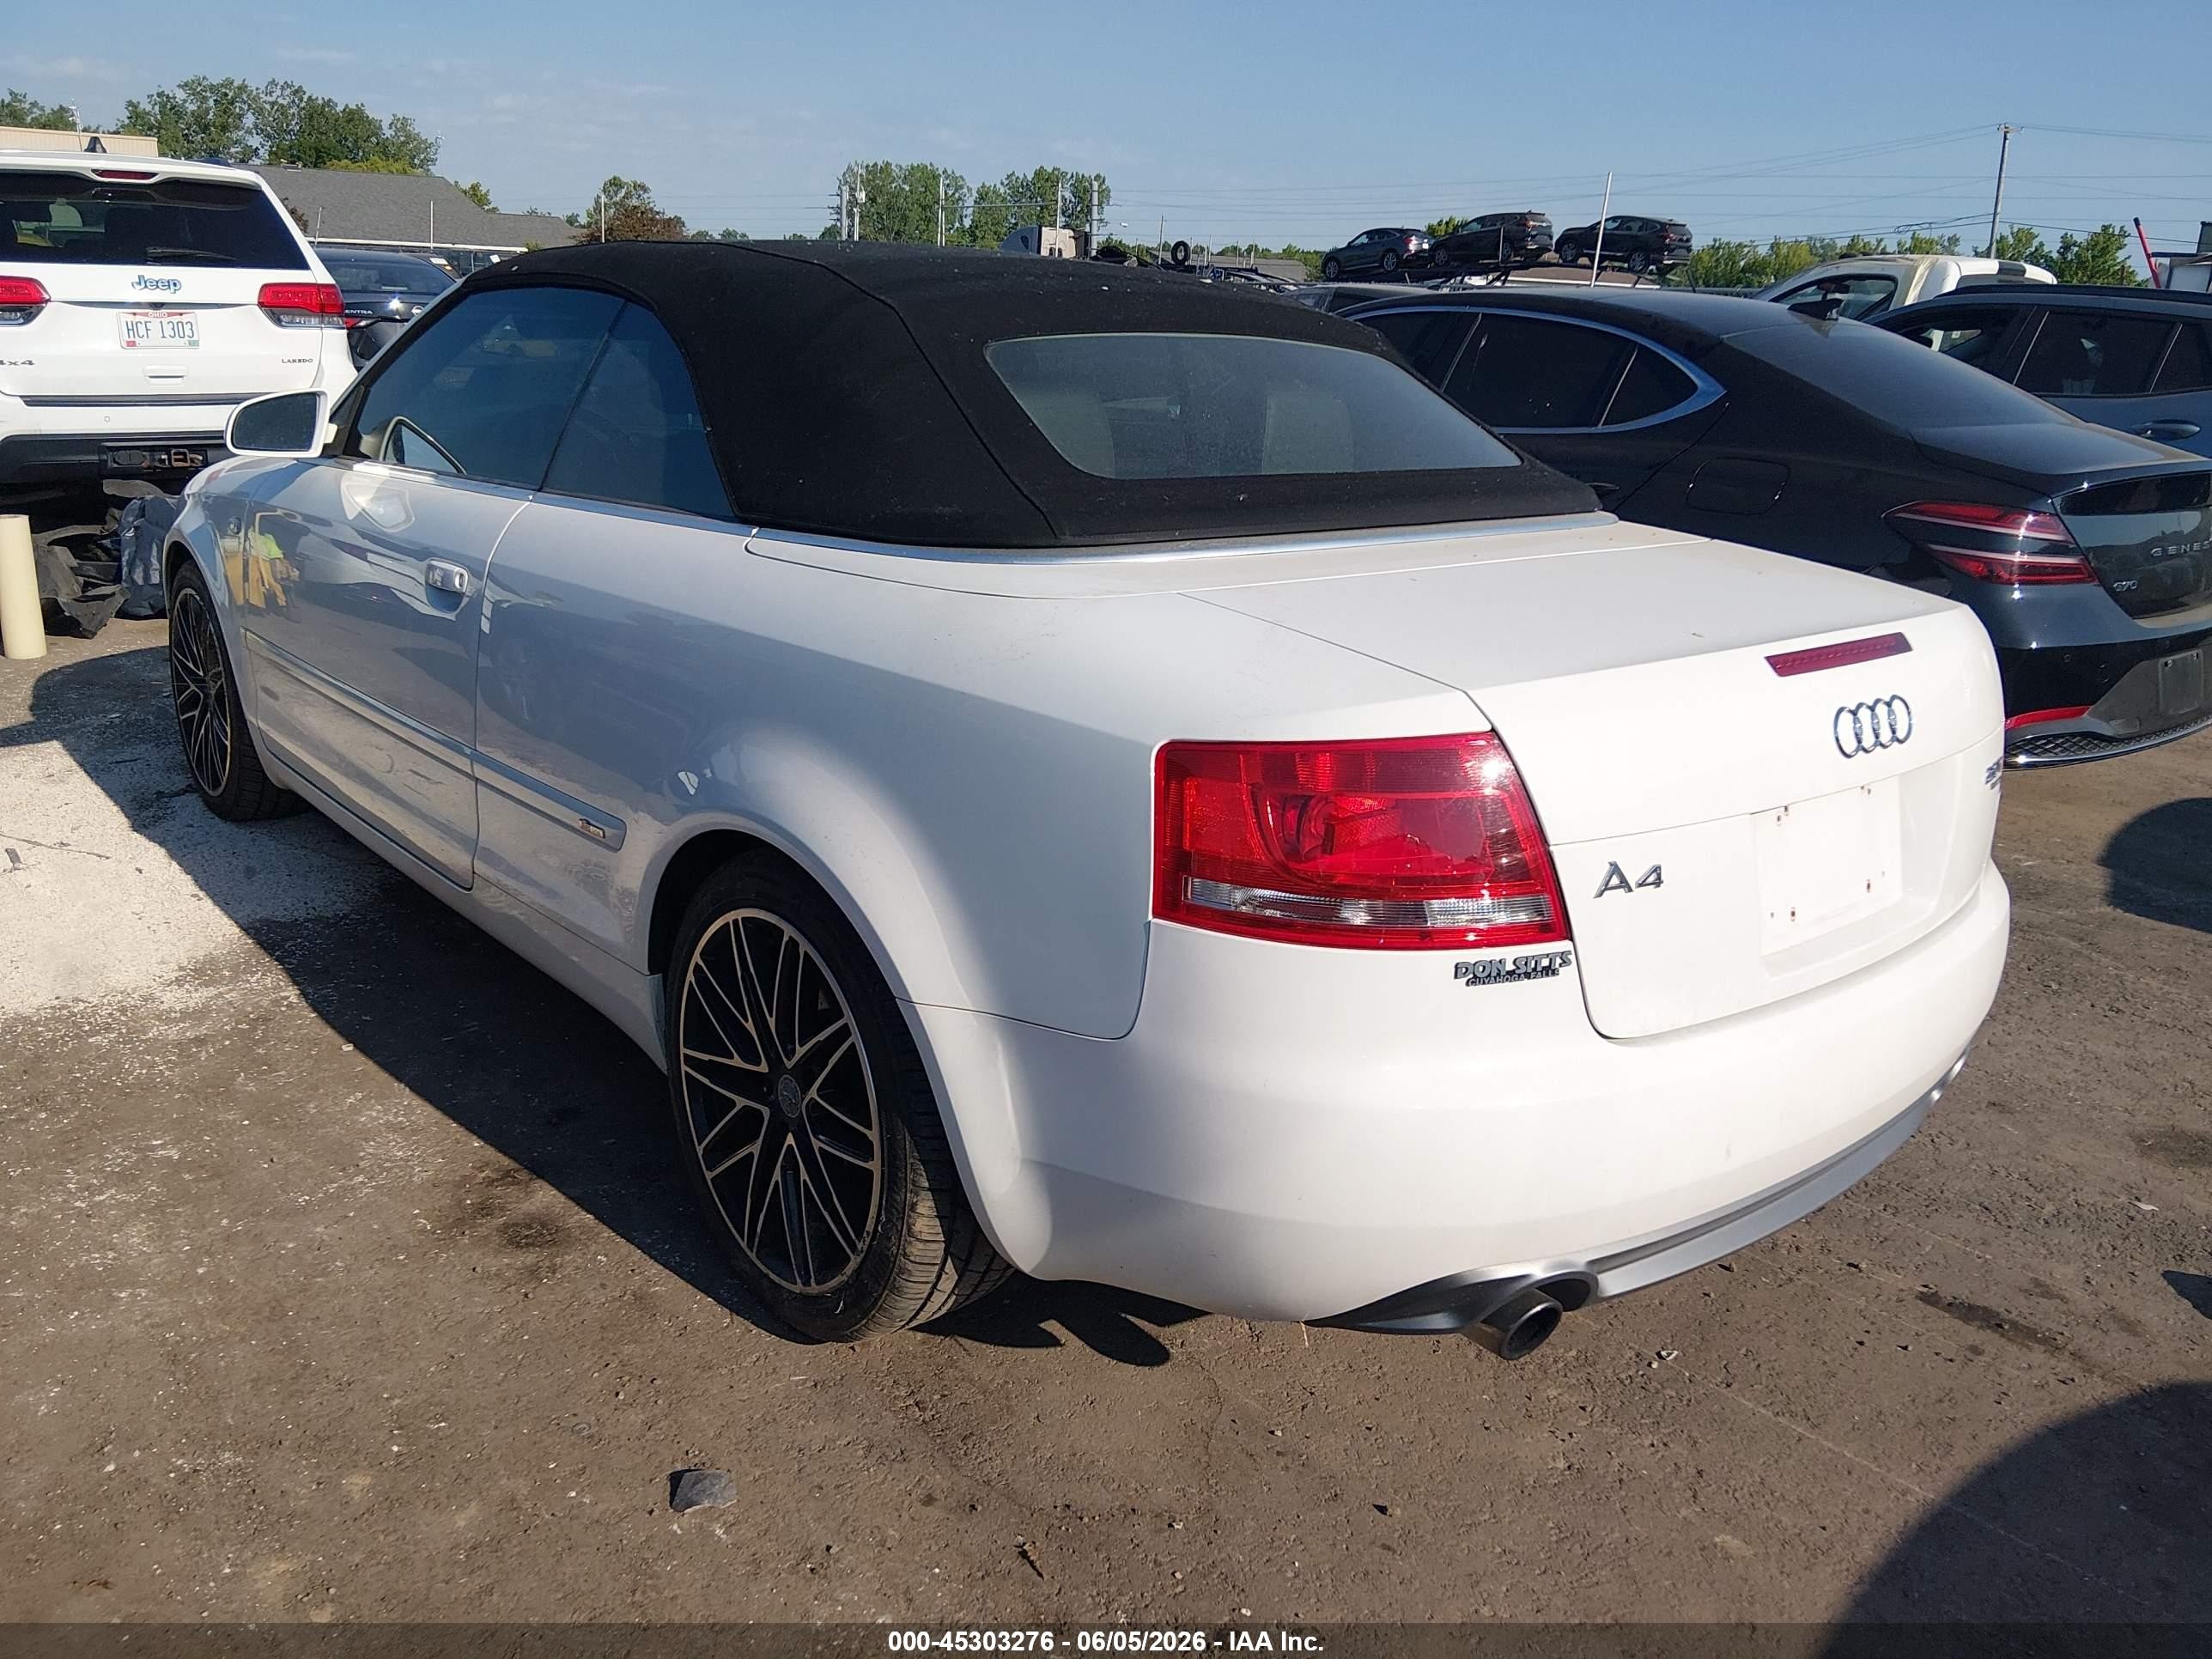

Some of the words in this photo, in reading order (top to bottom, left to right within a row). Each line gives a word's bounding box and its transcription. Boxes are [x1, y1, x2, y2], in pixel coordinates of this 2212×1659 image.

[131, 274, 182, 294] Jeep
[125, 320, 152, 338] HCF
[159, 320, 194, 338] 1303
[1593, 860, 1664, 899] A4
[1454, 957, 1507, 980] DON
[1512, 951, 1573, 975] SITTS
[1465, 973, 1526, 987] CUYAHOGA
[1530, 967, 1560, 981] FALLS
